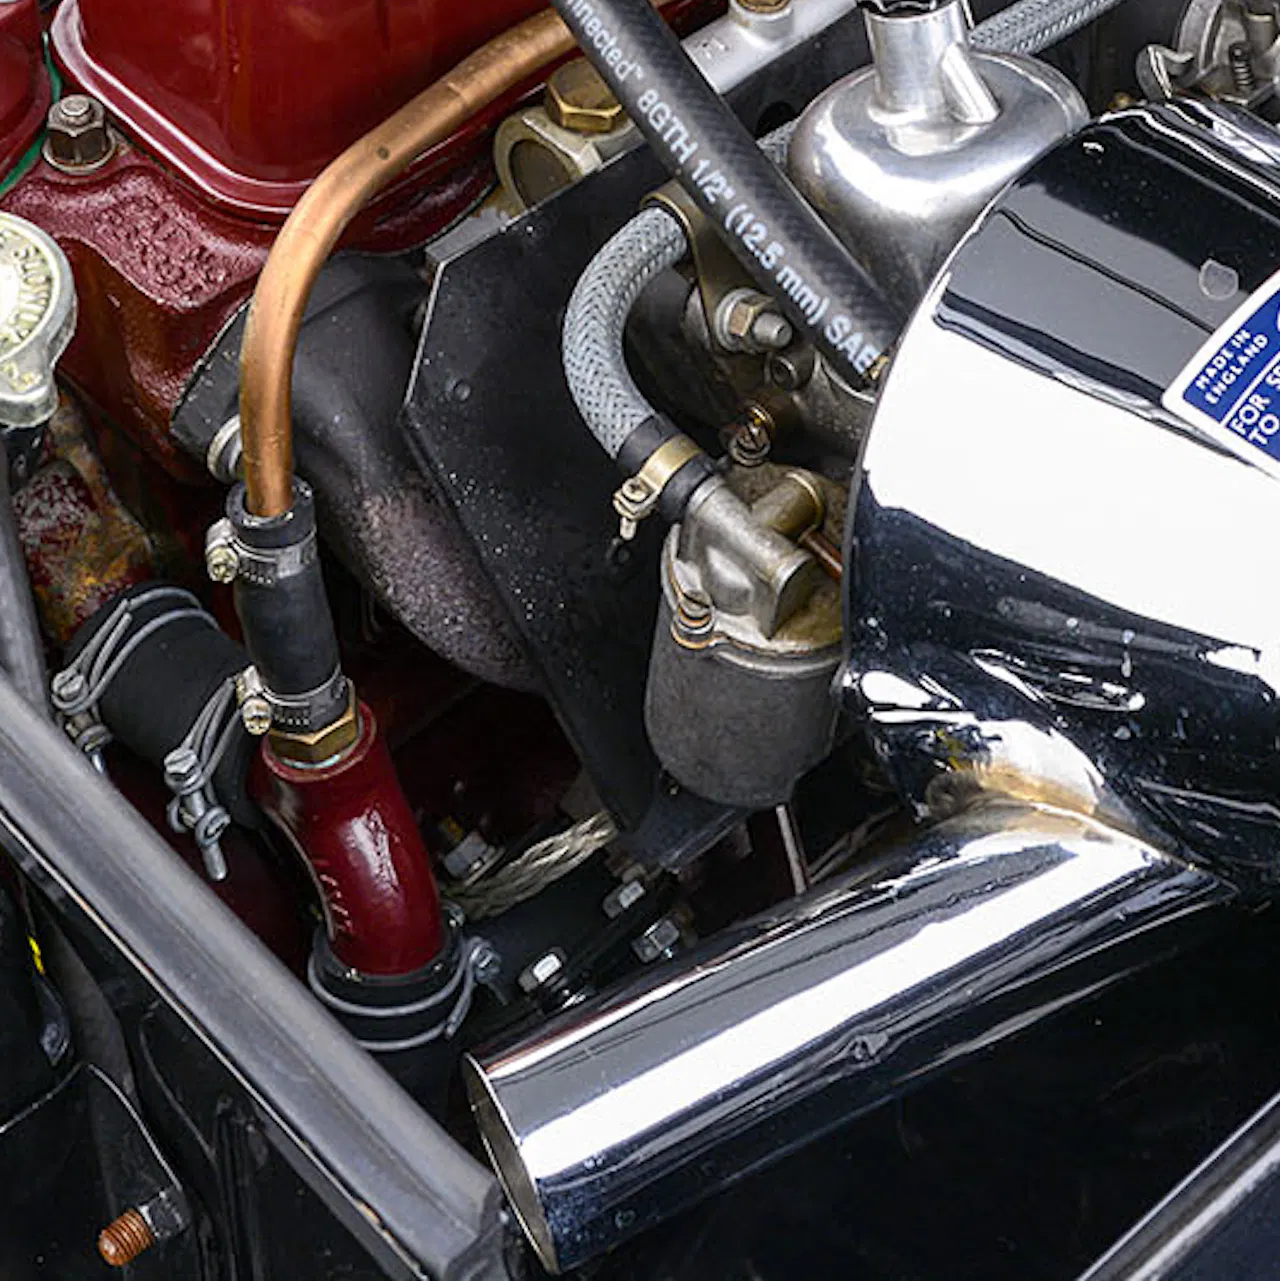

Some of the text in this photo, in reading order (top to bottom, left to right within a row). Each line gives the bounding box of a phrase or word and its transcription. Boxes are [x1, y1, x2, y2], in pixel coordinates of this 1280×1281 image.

[637, 90, 696, 163] 8GTH
[722, 207, 778, 270] (12.5
[776, 264, 828, 325] mm)
[10, 245, 53, 346] SLOWLY
[1196, 330, 1252, 390] MADE IN
[1205, 335, 1268, 405] ENGLAND
[1230, 393, 1269, 436] FOR
[1250, 414, 1280, 446] TO
